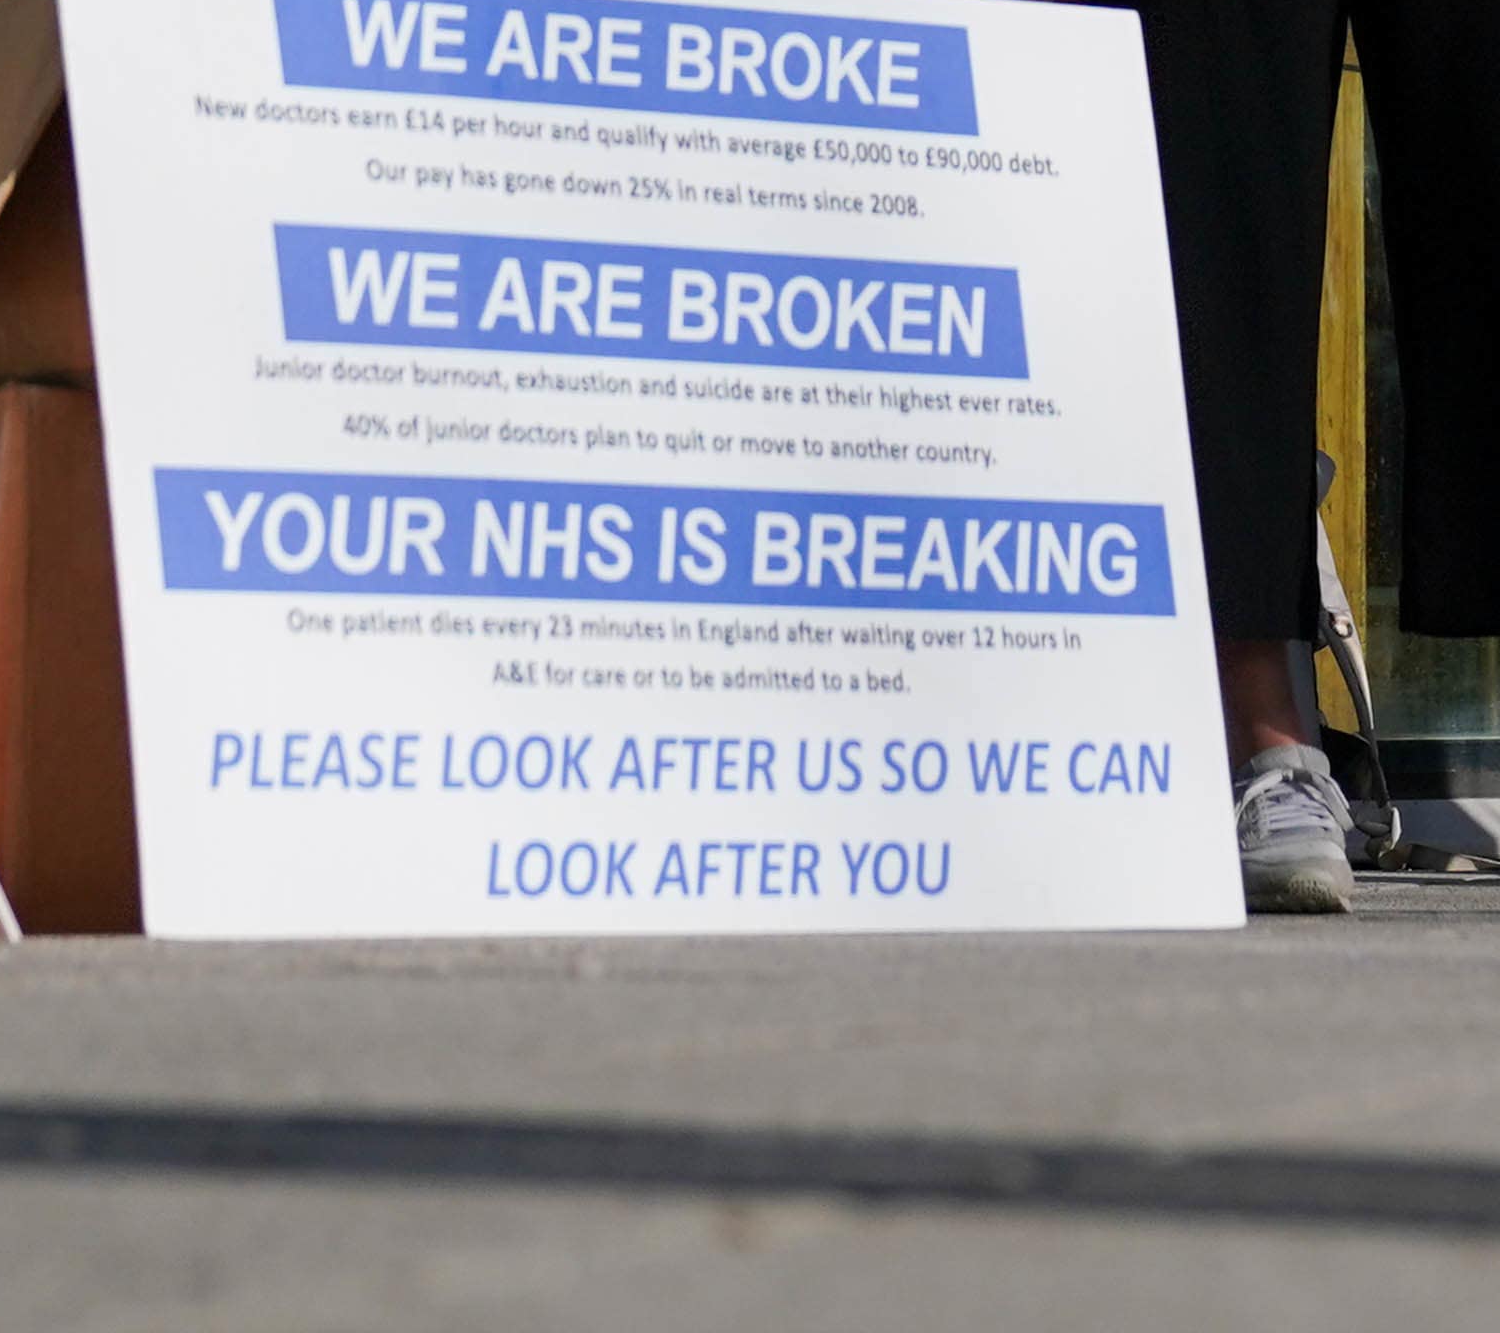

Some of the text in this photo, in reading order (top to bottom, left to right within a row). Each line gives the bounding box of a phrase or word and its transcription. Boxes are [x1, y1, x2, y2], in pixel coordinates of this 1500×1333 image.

[486, 9, 642, 87] ARE
[666, 23, 921, 108] BROKE
[195, 95, 1059, 177] New doctors earn £14 per hour and qualify with average £50,000 to £90,000 debt.
[365, 158, 925, 218] Our pay has gone down 25% in real terms since 2008.
[328, 247, 986, 357] WE ARE BROKEN
[255, 358, 1061, 417] Junior doctor burnout, exhaustion and suicide are at their highest ever rates.
[343, 414, 997, 470] 40% of junior doctors plan to quit or move to another country.
[203, 490, 1137, 597] YOUR NHS IS BREAKING
[287, 608, 1082, 653] One patient dies every 23 minutes in England after waiting over 12 hours in
[492, 660, 911, 694] A&E for care or to be admitted to a bed.
[210, 732, 1171, 795] PLEASE LOOK AFTER US SO WE CAN
[487, 841, 951, 898] LOOK AFTER YOU
